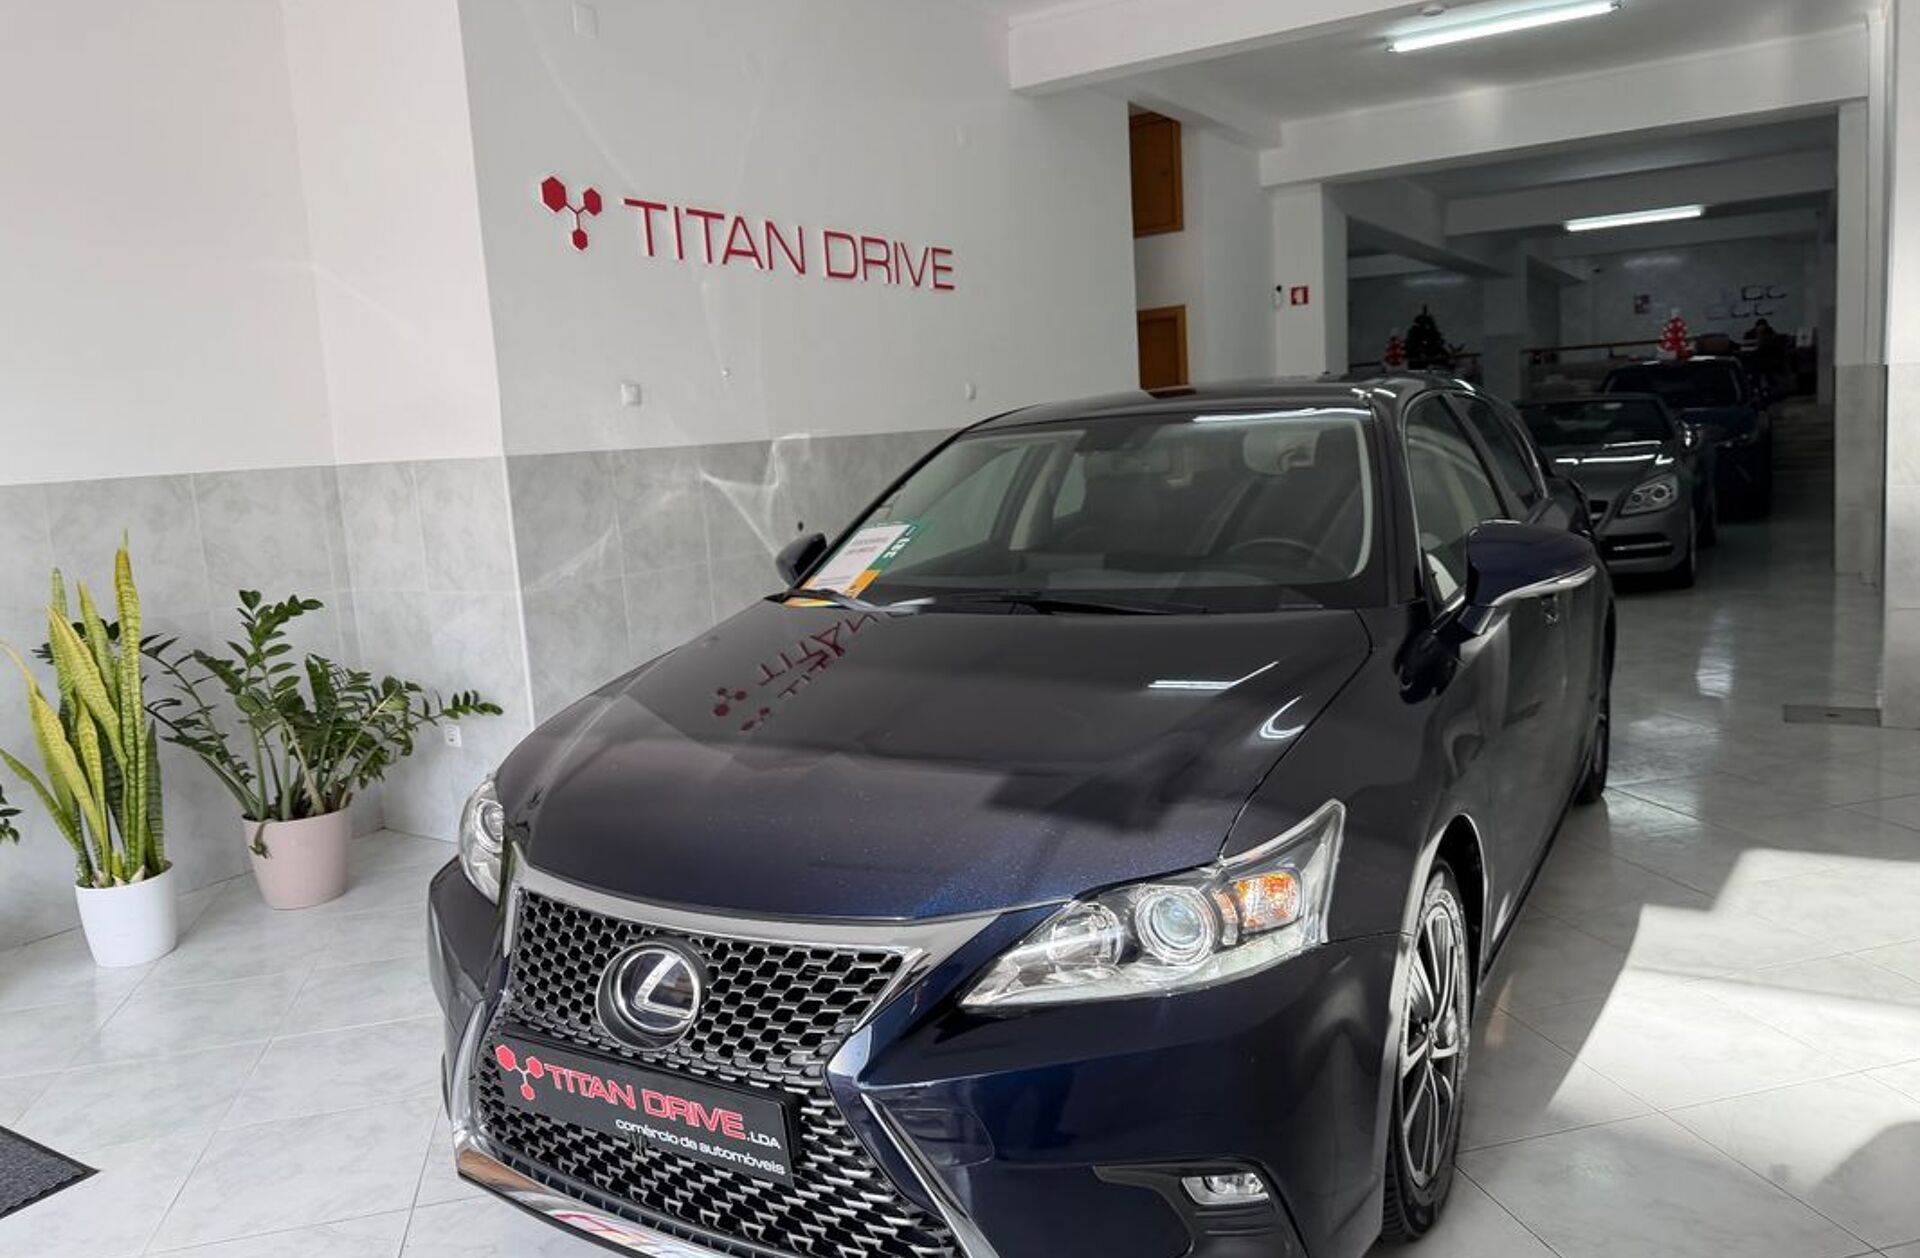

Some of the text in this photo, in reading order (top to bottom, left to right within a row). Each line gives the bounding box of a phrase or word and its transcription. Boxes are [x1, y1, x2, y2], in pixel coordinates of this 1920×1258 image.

[623, 198, 956, 291] TITAN DRIVE
[543, 1063, 637, 1111] TITAN
[615, 1118, 786, 1175] comércio de automóveis
